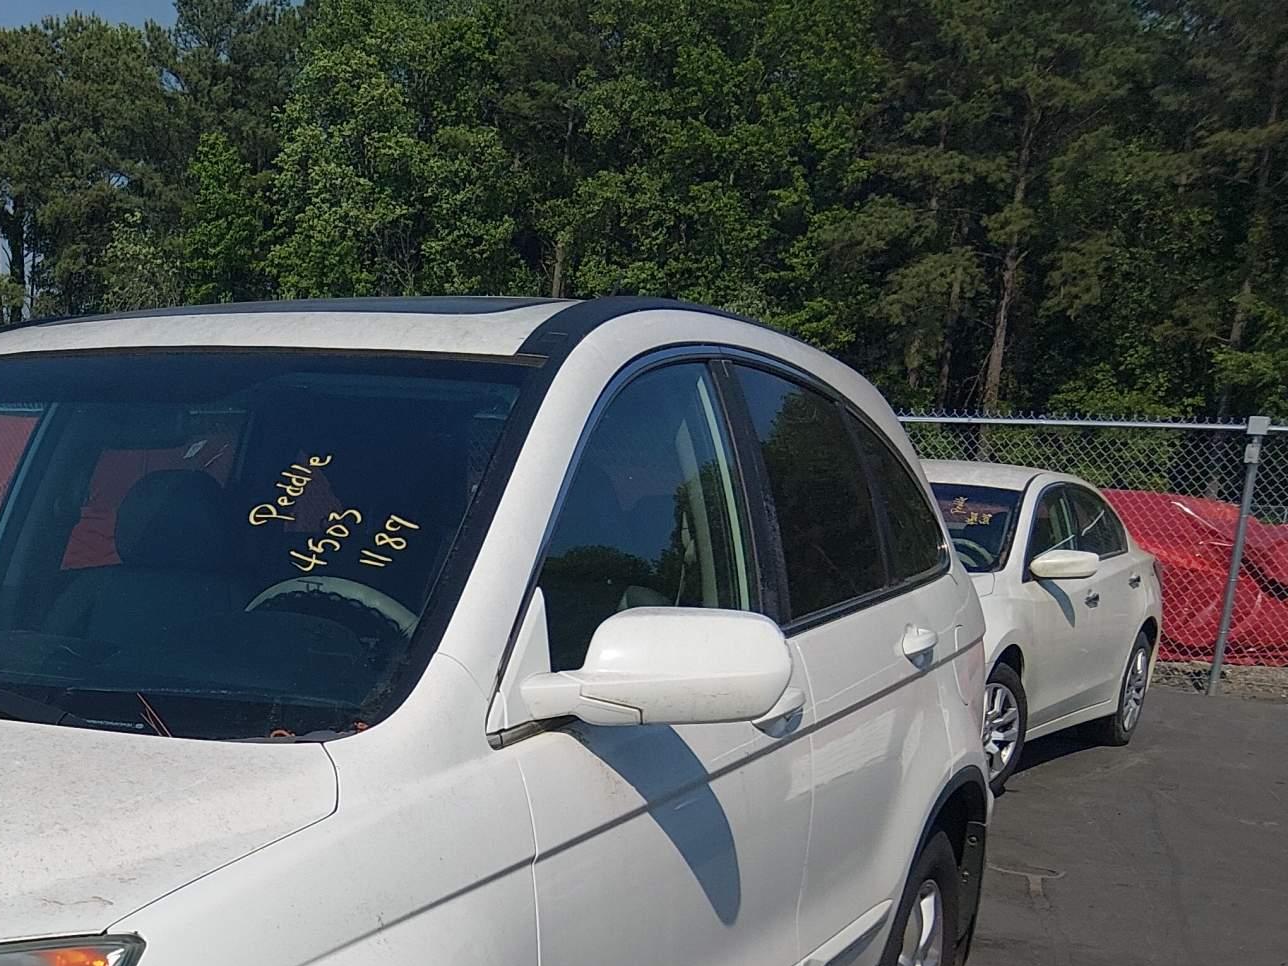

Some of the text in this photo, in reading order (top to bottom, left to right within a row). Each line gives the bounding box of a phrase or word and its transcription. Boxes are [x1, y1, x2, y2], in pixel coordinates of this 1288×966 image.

[249, 455, 332, 526] Peddle
[289, 509, 362, 572] 4503
[359, 514, 420, 567] 1189
